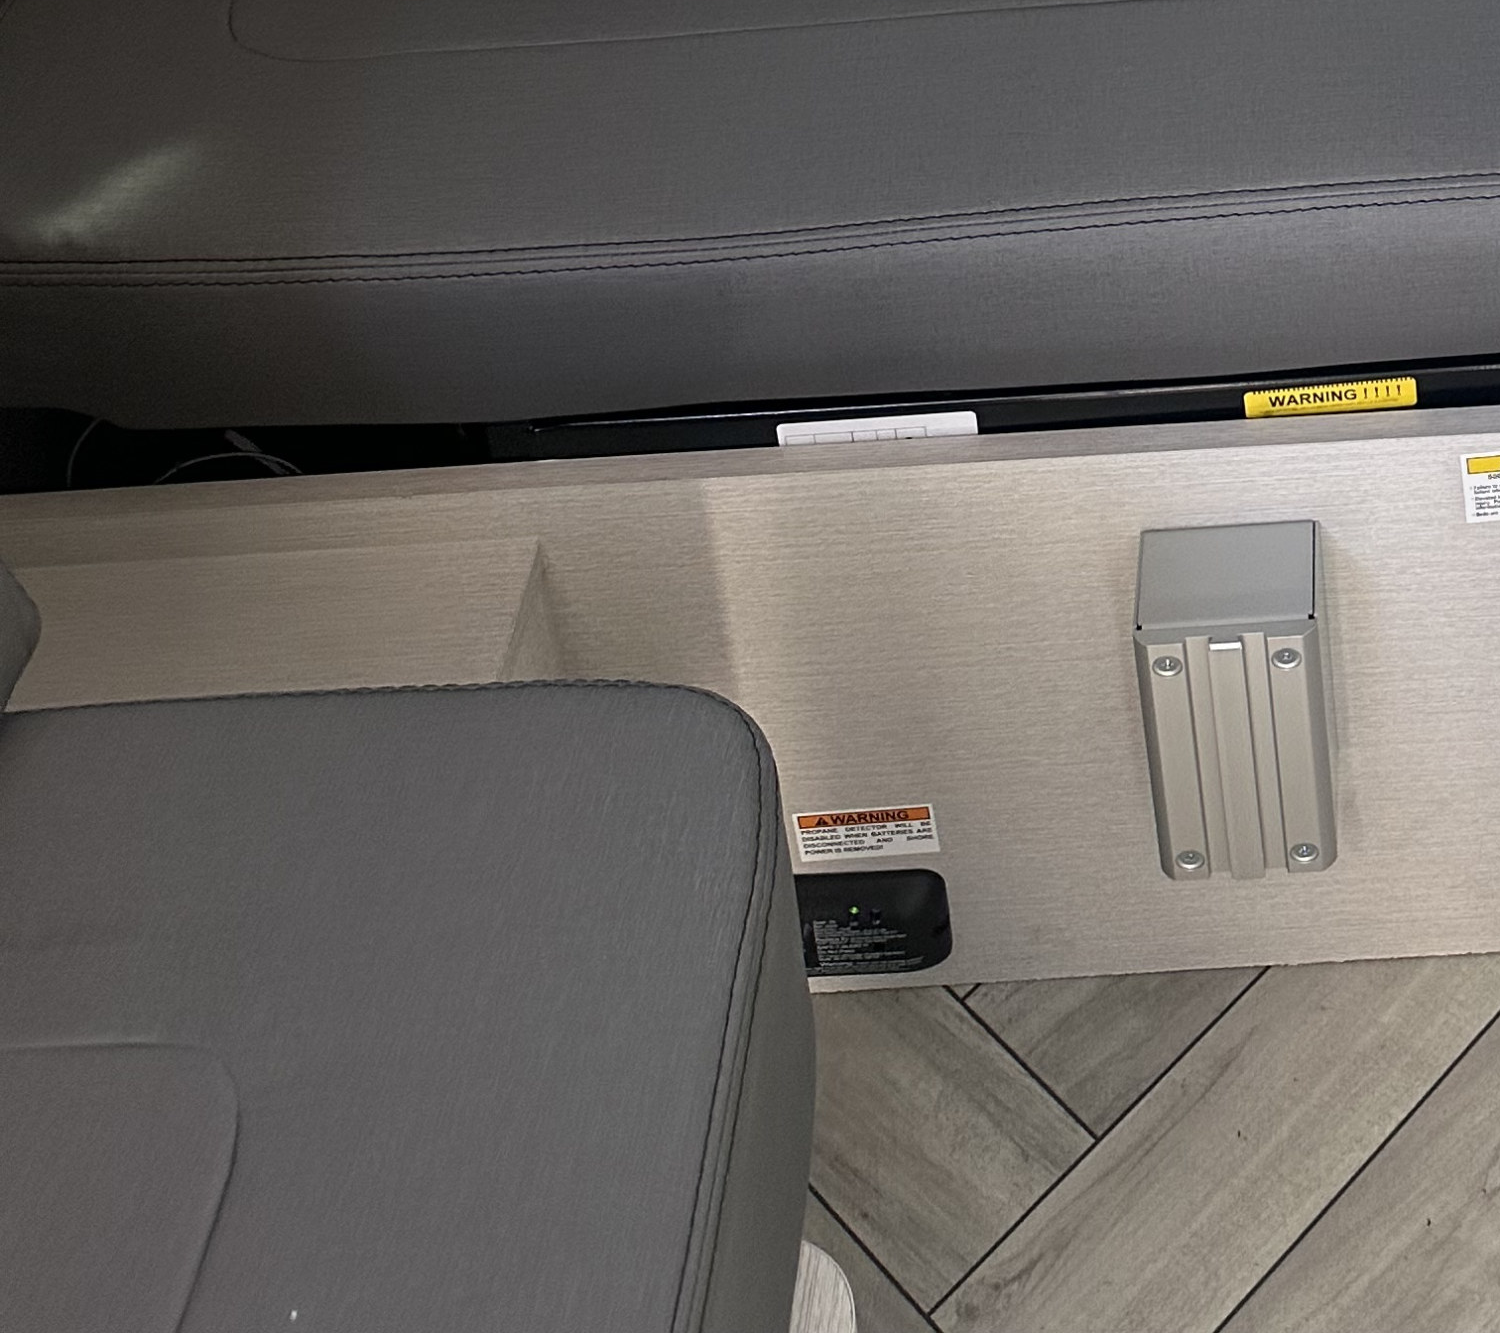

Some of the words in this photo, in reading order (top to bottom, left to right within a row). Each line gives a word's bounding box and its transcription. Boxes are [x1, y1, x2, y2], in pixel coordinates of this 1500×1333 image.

[1269, 388, 1357, 408] WARNING
[830, 811, 909, 825] WARNING
[845, 824, 887, 832] DETECTOR
